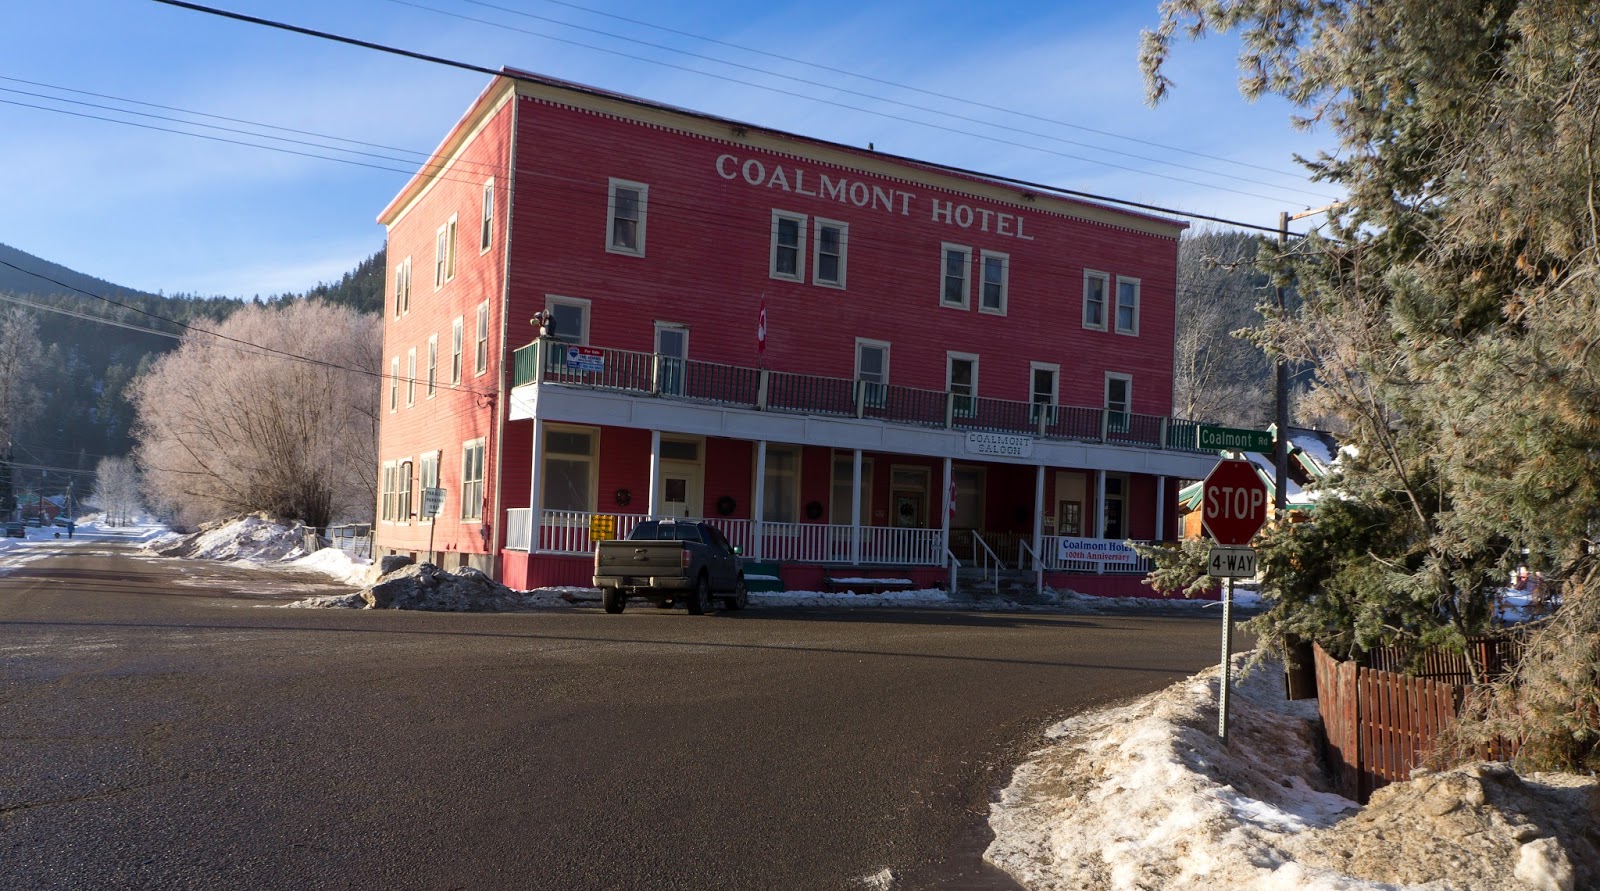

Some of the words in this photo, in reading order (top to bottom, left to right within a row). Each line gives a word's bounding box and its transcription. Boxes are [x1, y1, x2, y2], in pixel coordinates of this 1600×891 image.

[715, 154, 916, 216] COALMONT
[931, 198, 1034, 240] HOTEL
[970, 434, 1030, 446] COALMONT
[1202, 429, 1252, 447] Coalmont
[1258, 437, 1268, 446] Rd
[979, 444, 1021, 455] SALOON
[1207, 485, 1263, 520] STOP
[1063, 540, 1107, 551] Coalmont
[1065, 551, 1085, 559] 100th
[1087, 552, 1130, 562] Anniversary
[1212, 554, 1254, 572] 4-WAY
